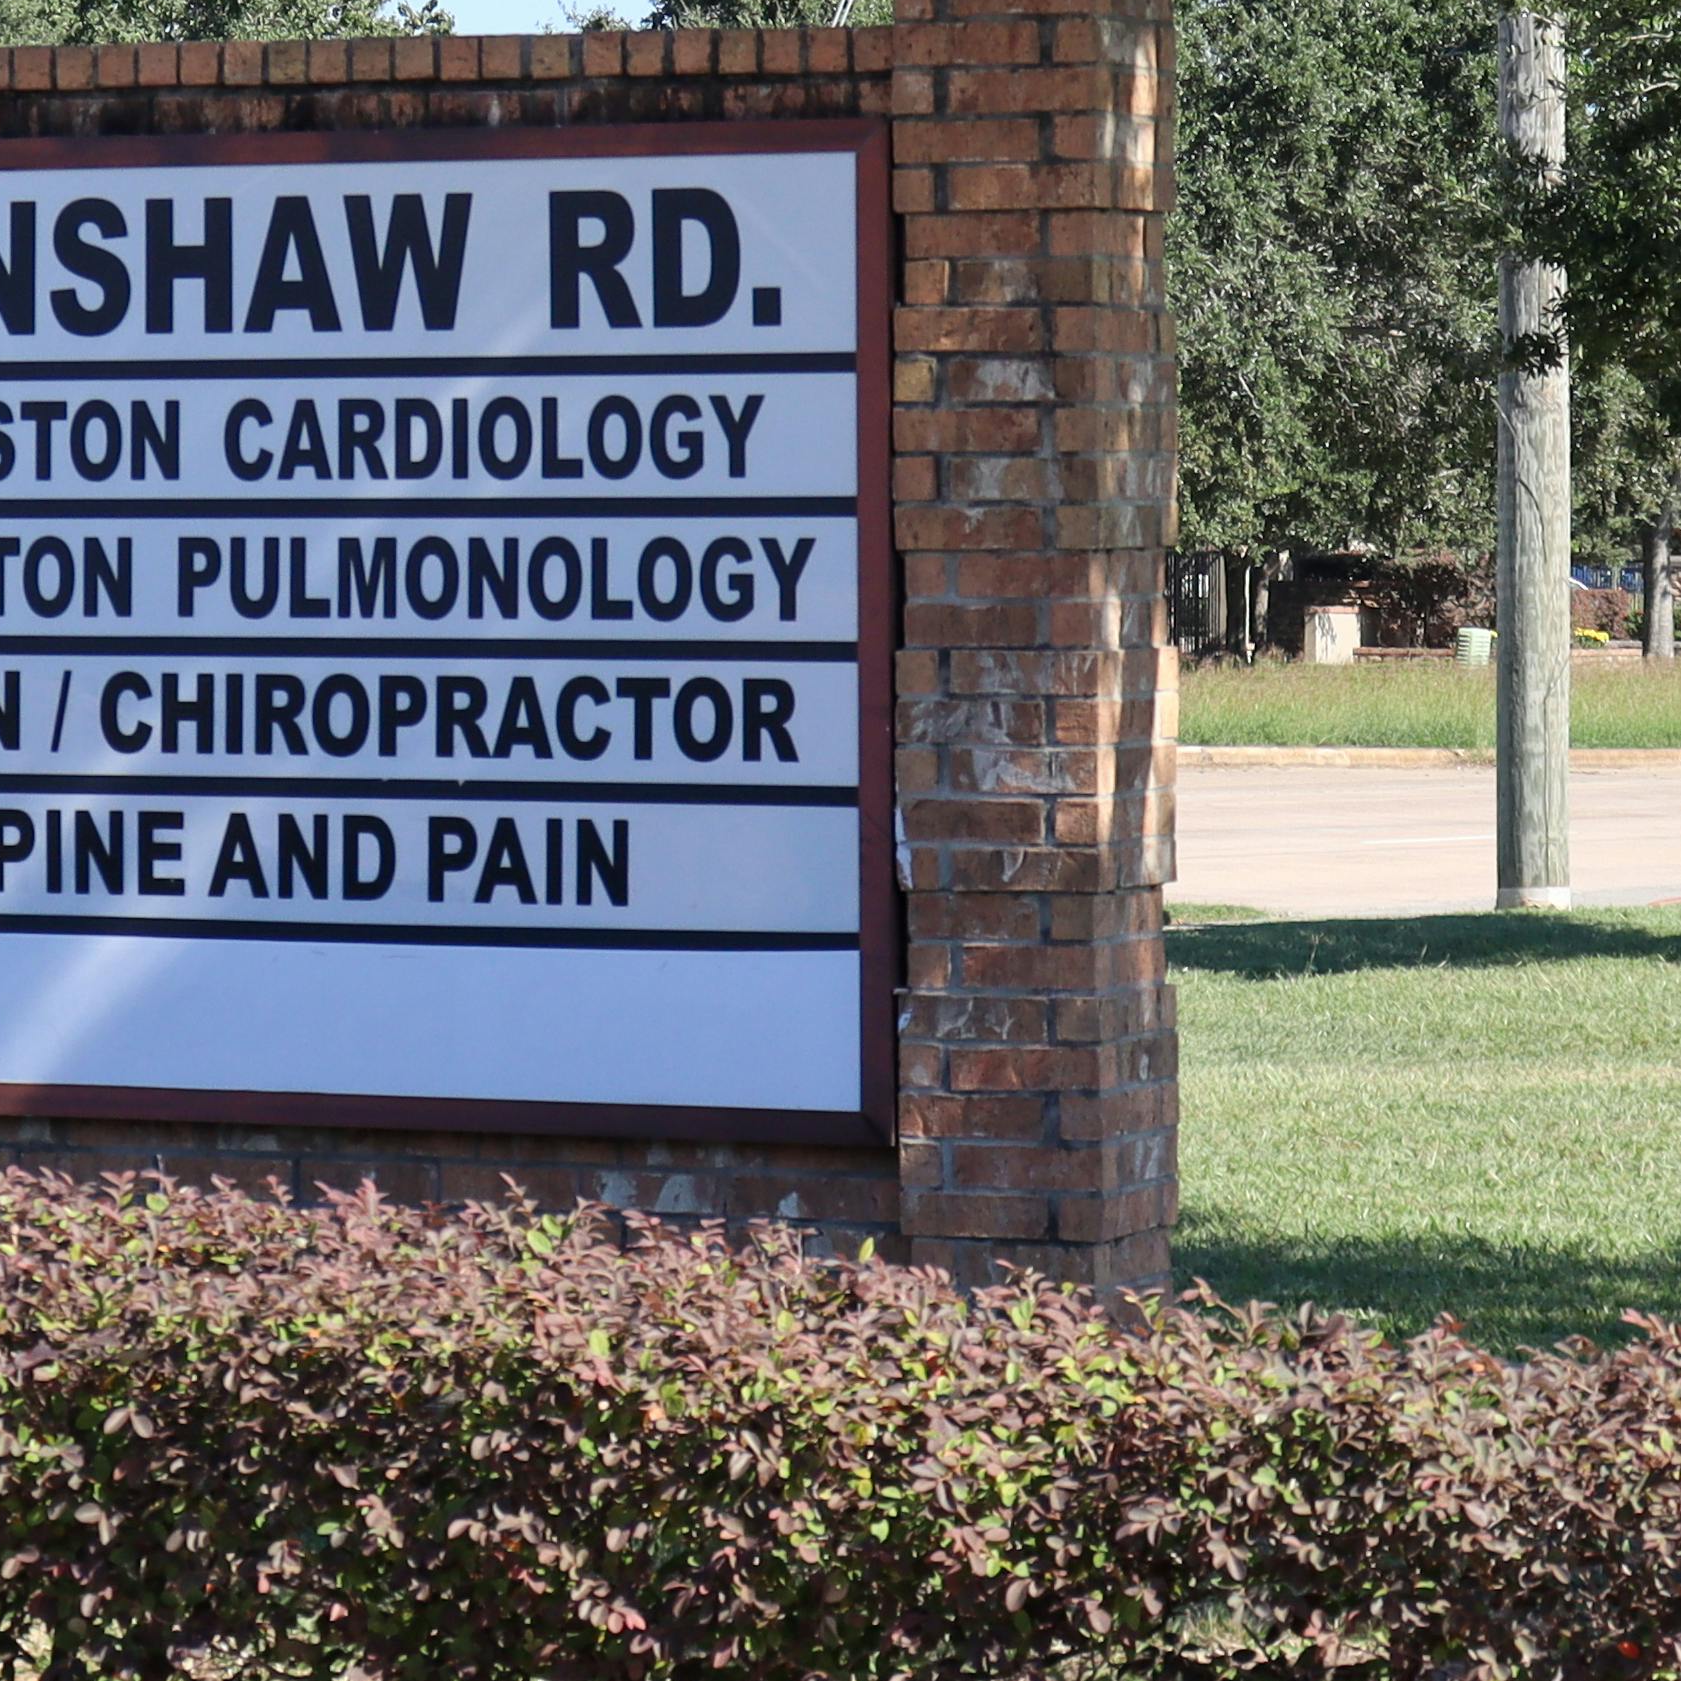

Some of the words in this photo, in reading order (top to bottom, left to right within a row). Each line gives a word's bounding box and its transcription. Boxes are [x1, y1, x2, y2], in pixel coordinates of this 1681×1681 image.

[548, 187, 782, 330] RD.
[223, 393, 765, 482] CARDIOLOGY
[177, 535, 817, 623] PULMONOLOGY
[50, 669, 73, 753] /
[99, 670, 800, 763] CHIROPRACTOR
[207, 812, 397, 902] AND
[427, 815, 630, 908] PAIN
